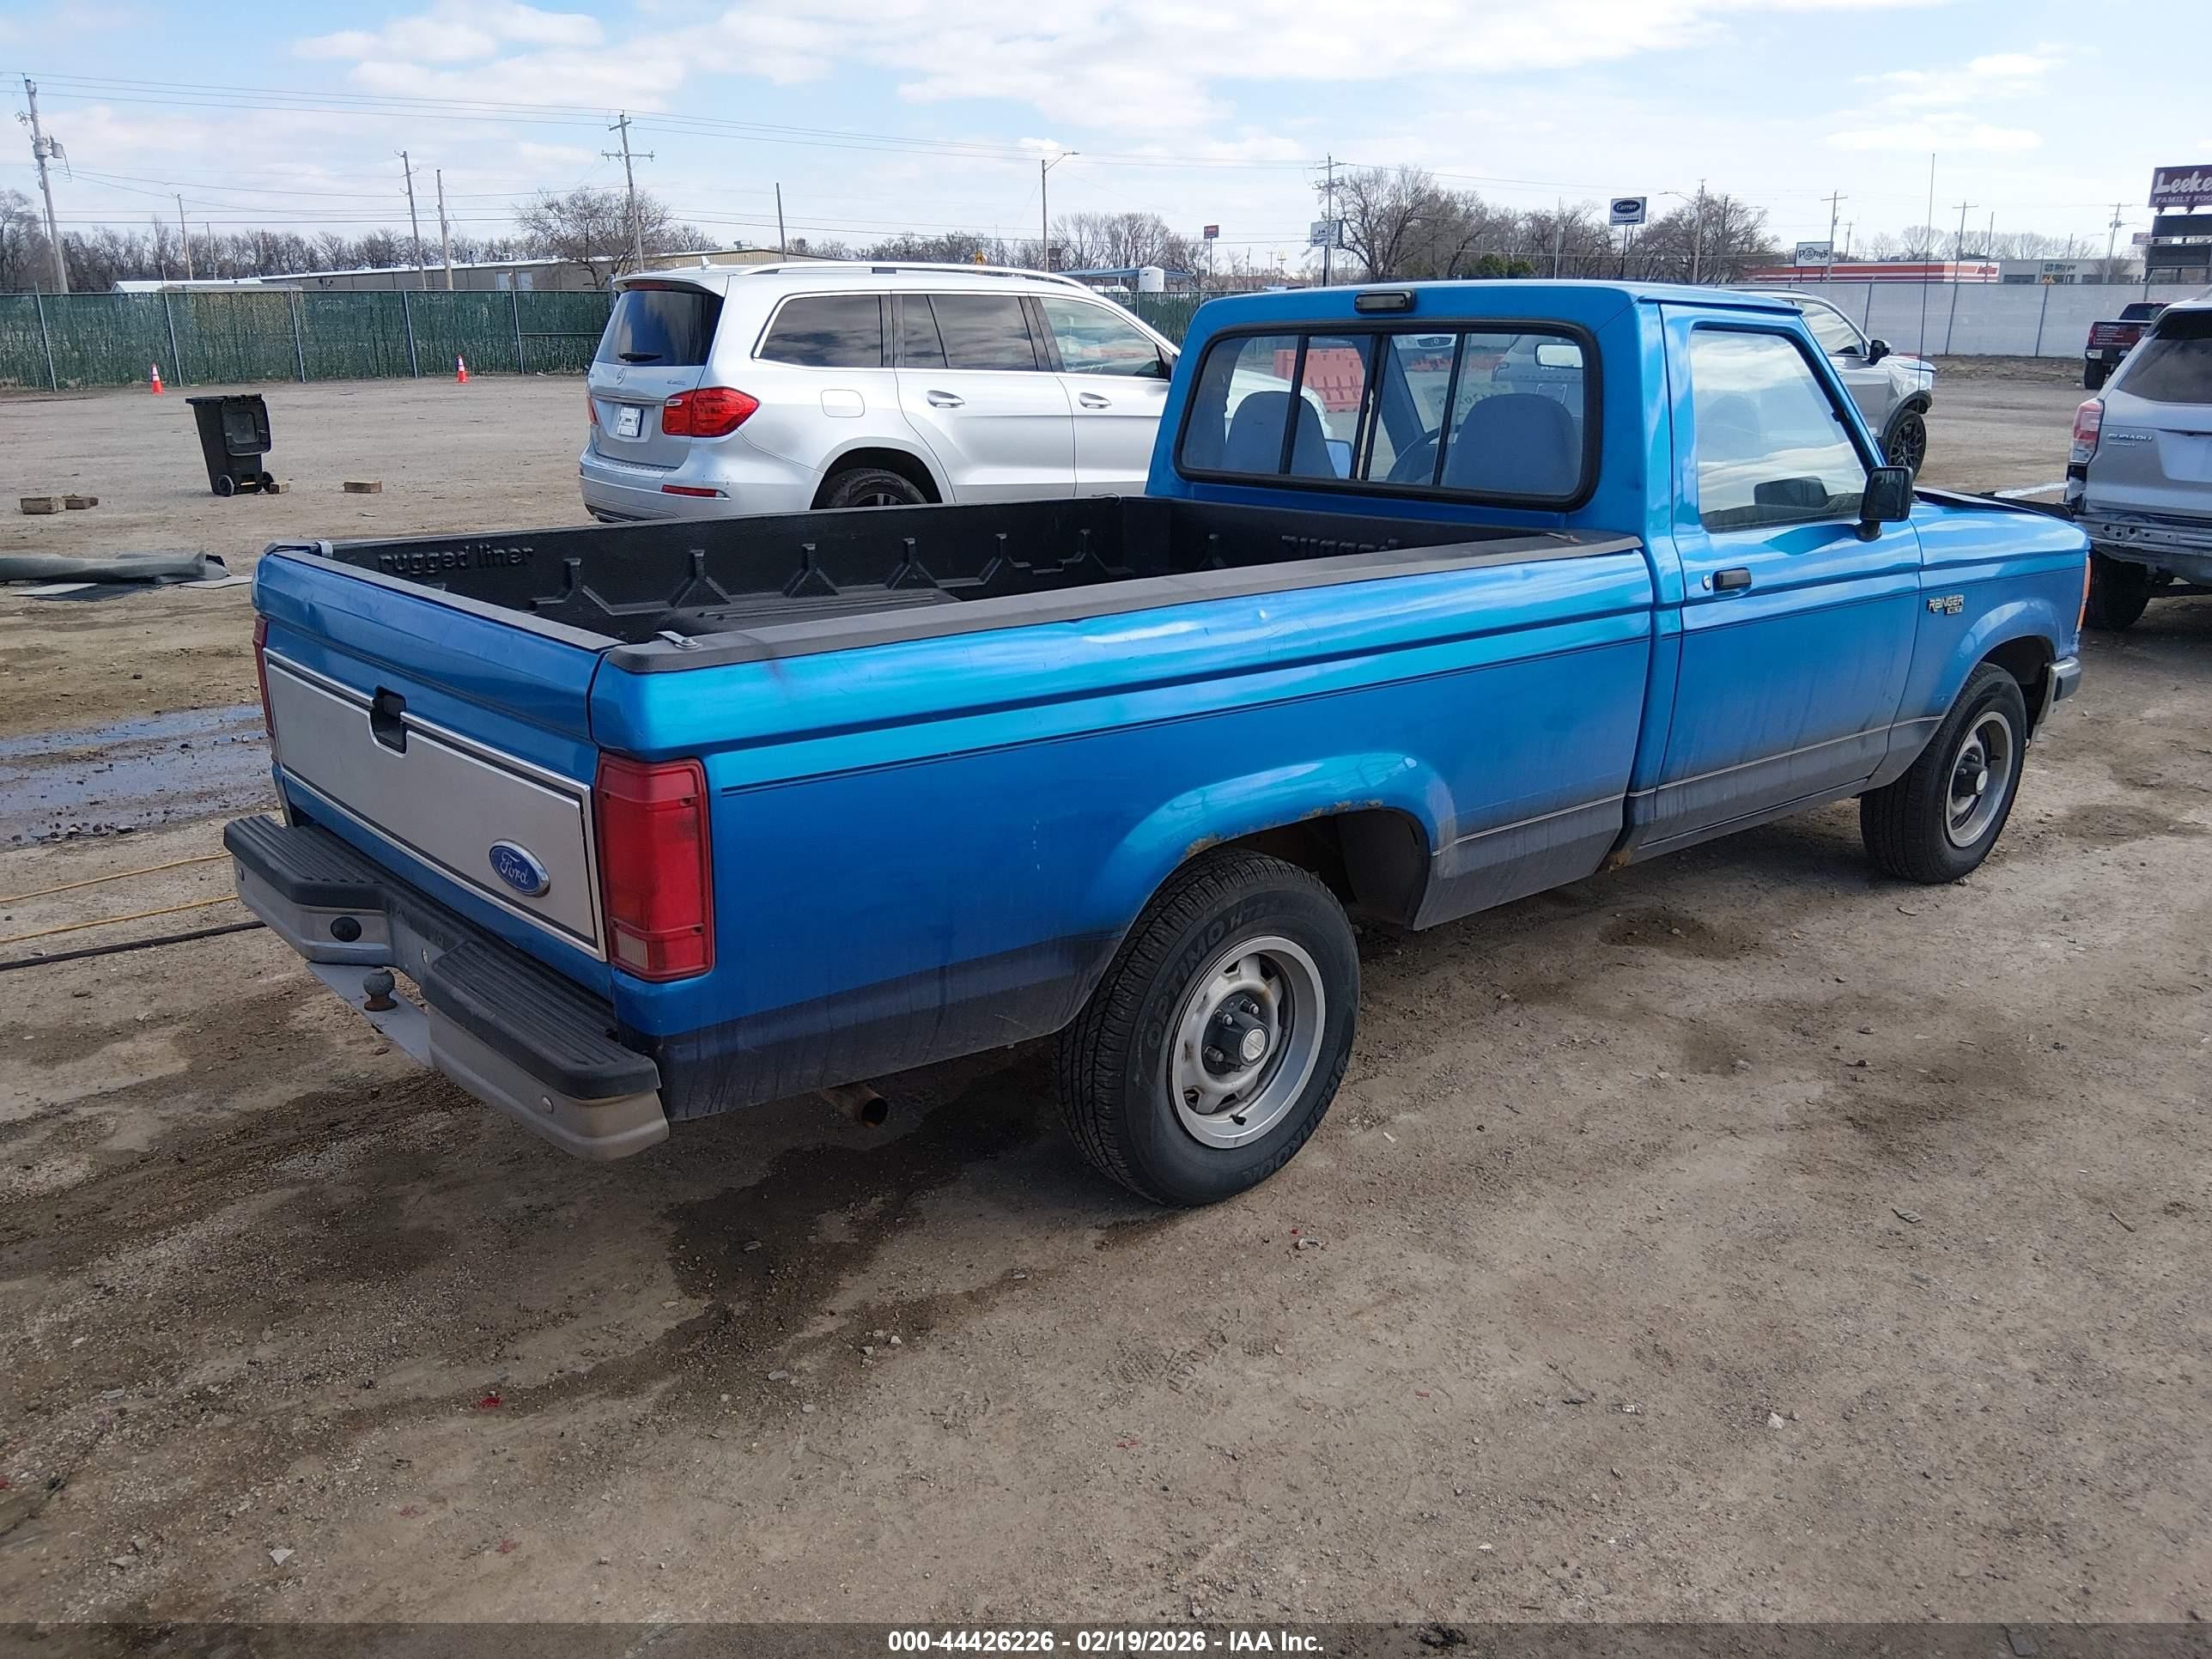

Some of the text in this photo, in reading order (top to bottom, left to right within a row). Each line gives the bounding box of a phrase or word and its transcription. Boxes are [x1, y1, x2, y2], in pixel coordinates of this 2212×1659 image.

[380, 544, 534, 574] rugged liner
[1929, 594, 1965, 612] RANGER
[501, 852, 529, 884] Ford
